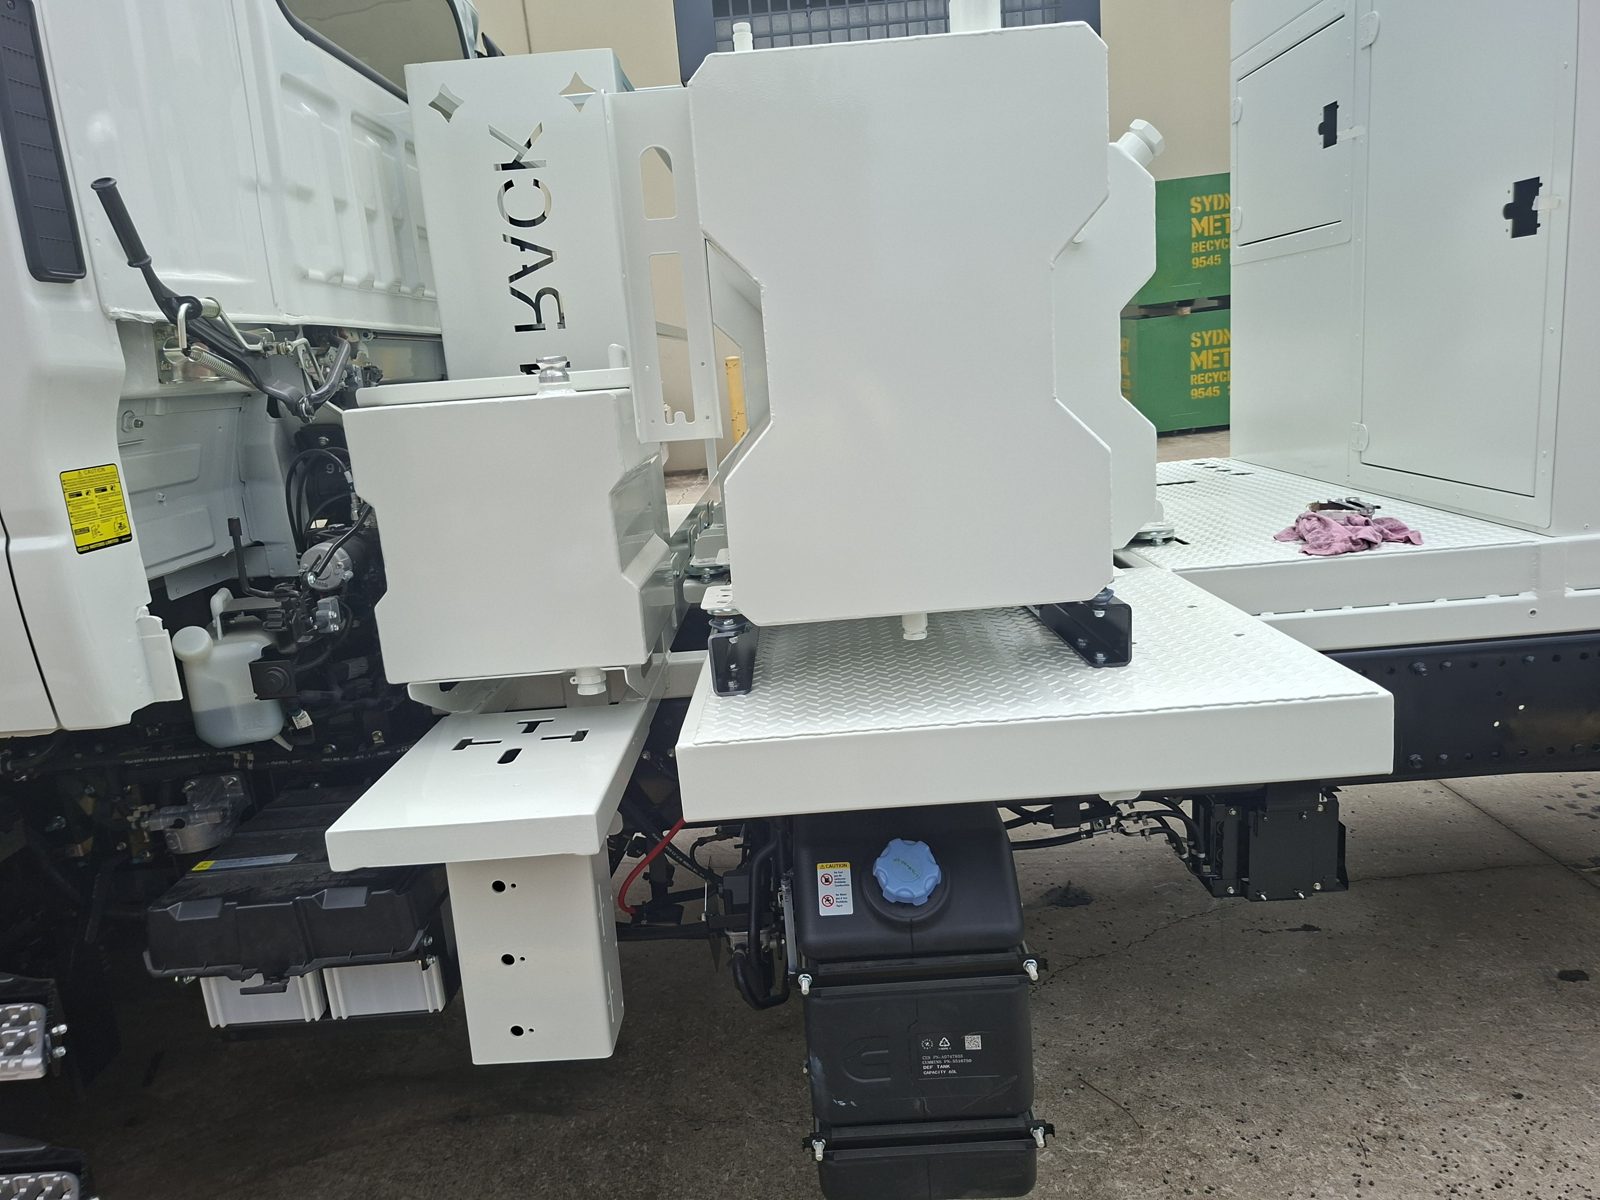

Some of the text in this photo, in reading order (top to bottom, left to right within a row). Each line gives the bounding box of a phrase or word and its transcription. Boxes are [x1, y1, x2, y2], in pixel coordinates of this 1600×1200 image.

[1191, 213, 1231, 238] MET
[1191, 255, 1221, 269] 9545
[1190, 347, 1231, 371] MET
[1190, 386, 1220, 399] 9545
